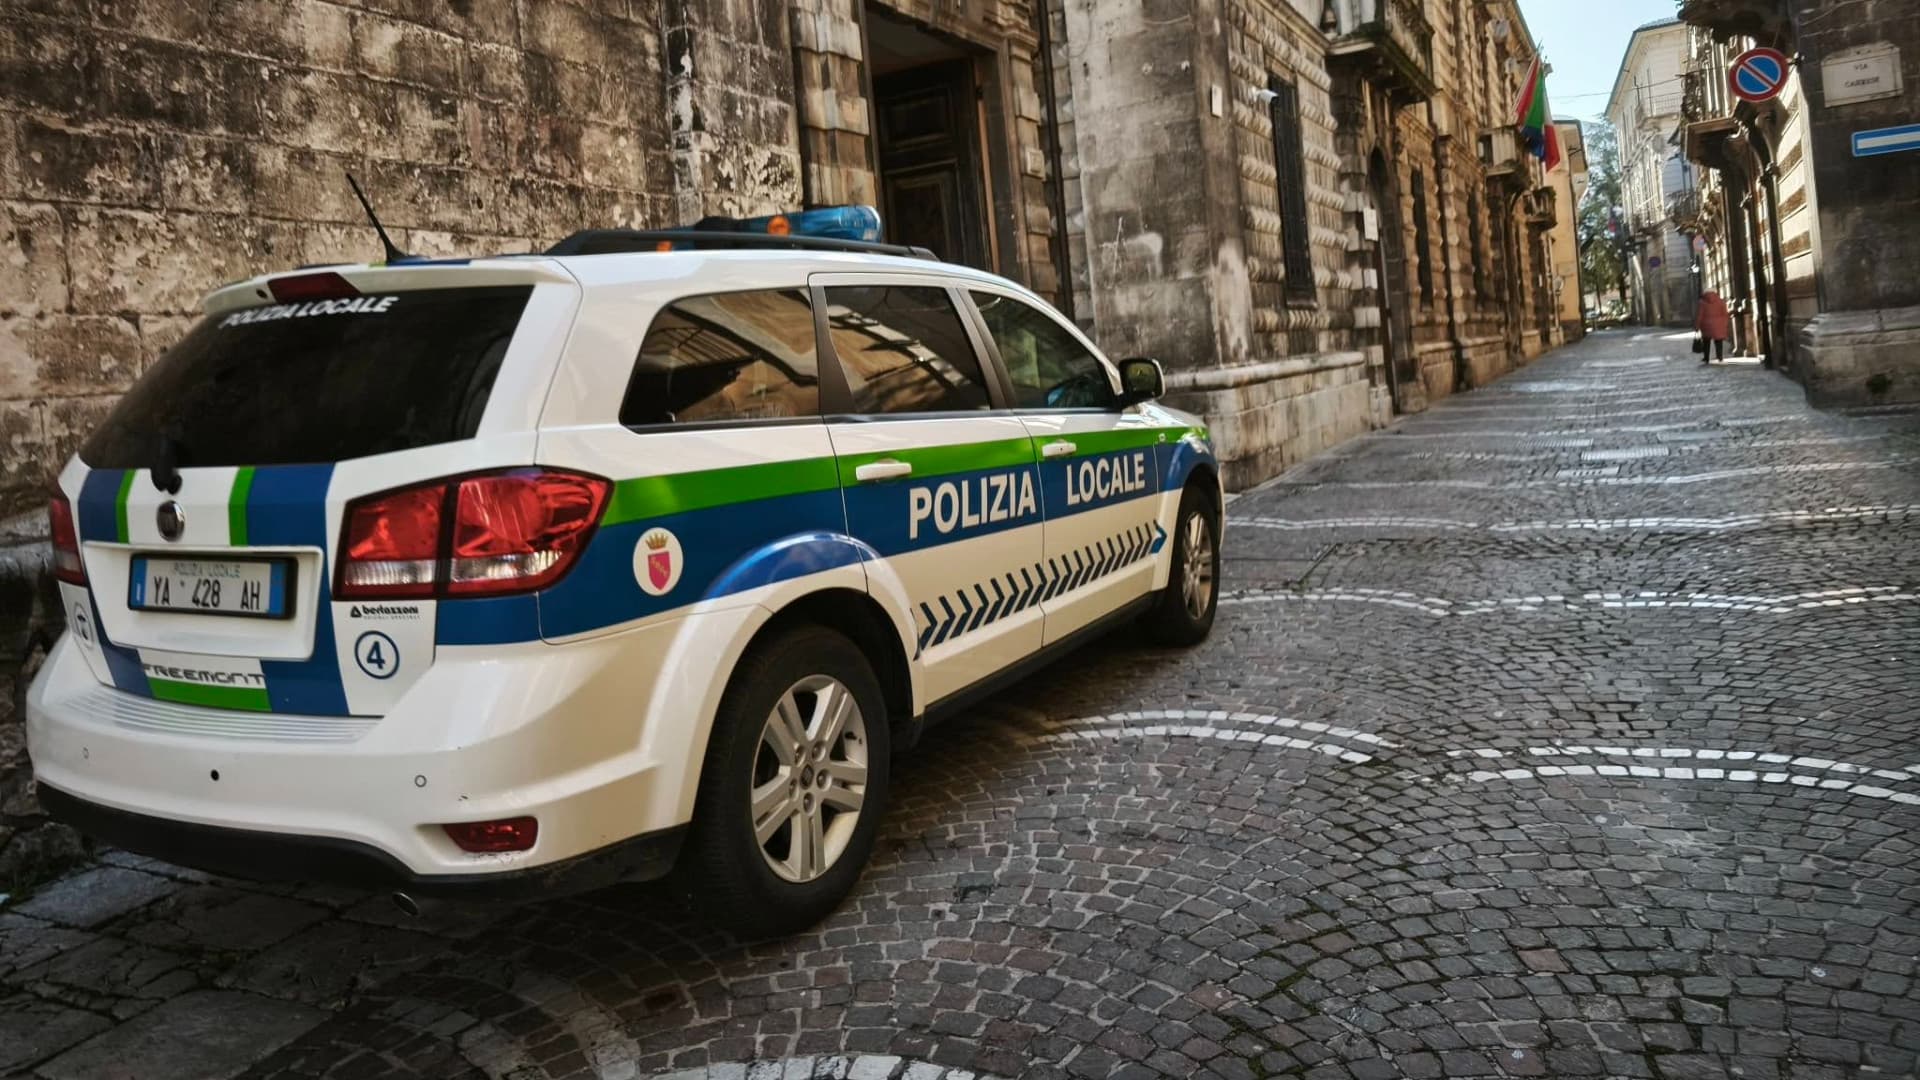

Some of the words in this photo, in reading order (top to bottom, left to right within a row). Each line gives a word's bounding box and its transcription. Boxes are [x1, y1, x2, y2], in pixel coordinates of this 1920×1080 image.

[218, 303, 299, 329] POLIZIA
[299, 296, 399, 317] LOCALE
[909, 470, 1037, 540] POLIZIA
[1066, 452, 1146, 506] LOCALE
[154, 576, 171, 606] YA
[191, 578, 222, 608] 428
[240, 580, 261, 611] AH
[366, 641, 386, 670] 4
[142, 663, 265, 686] FREEMONT
